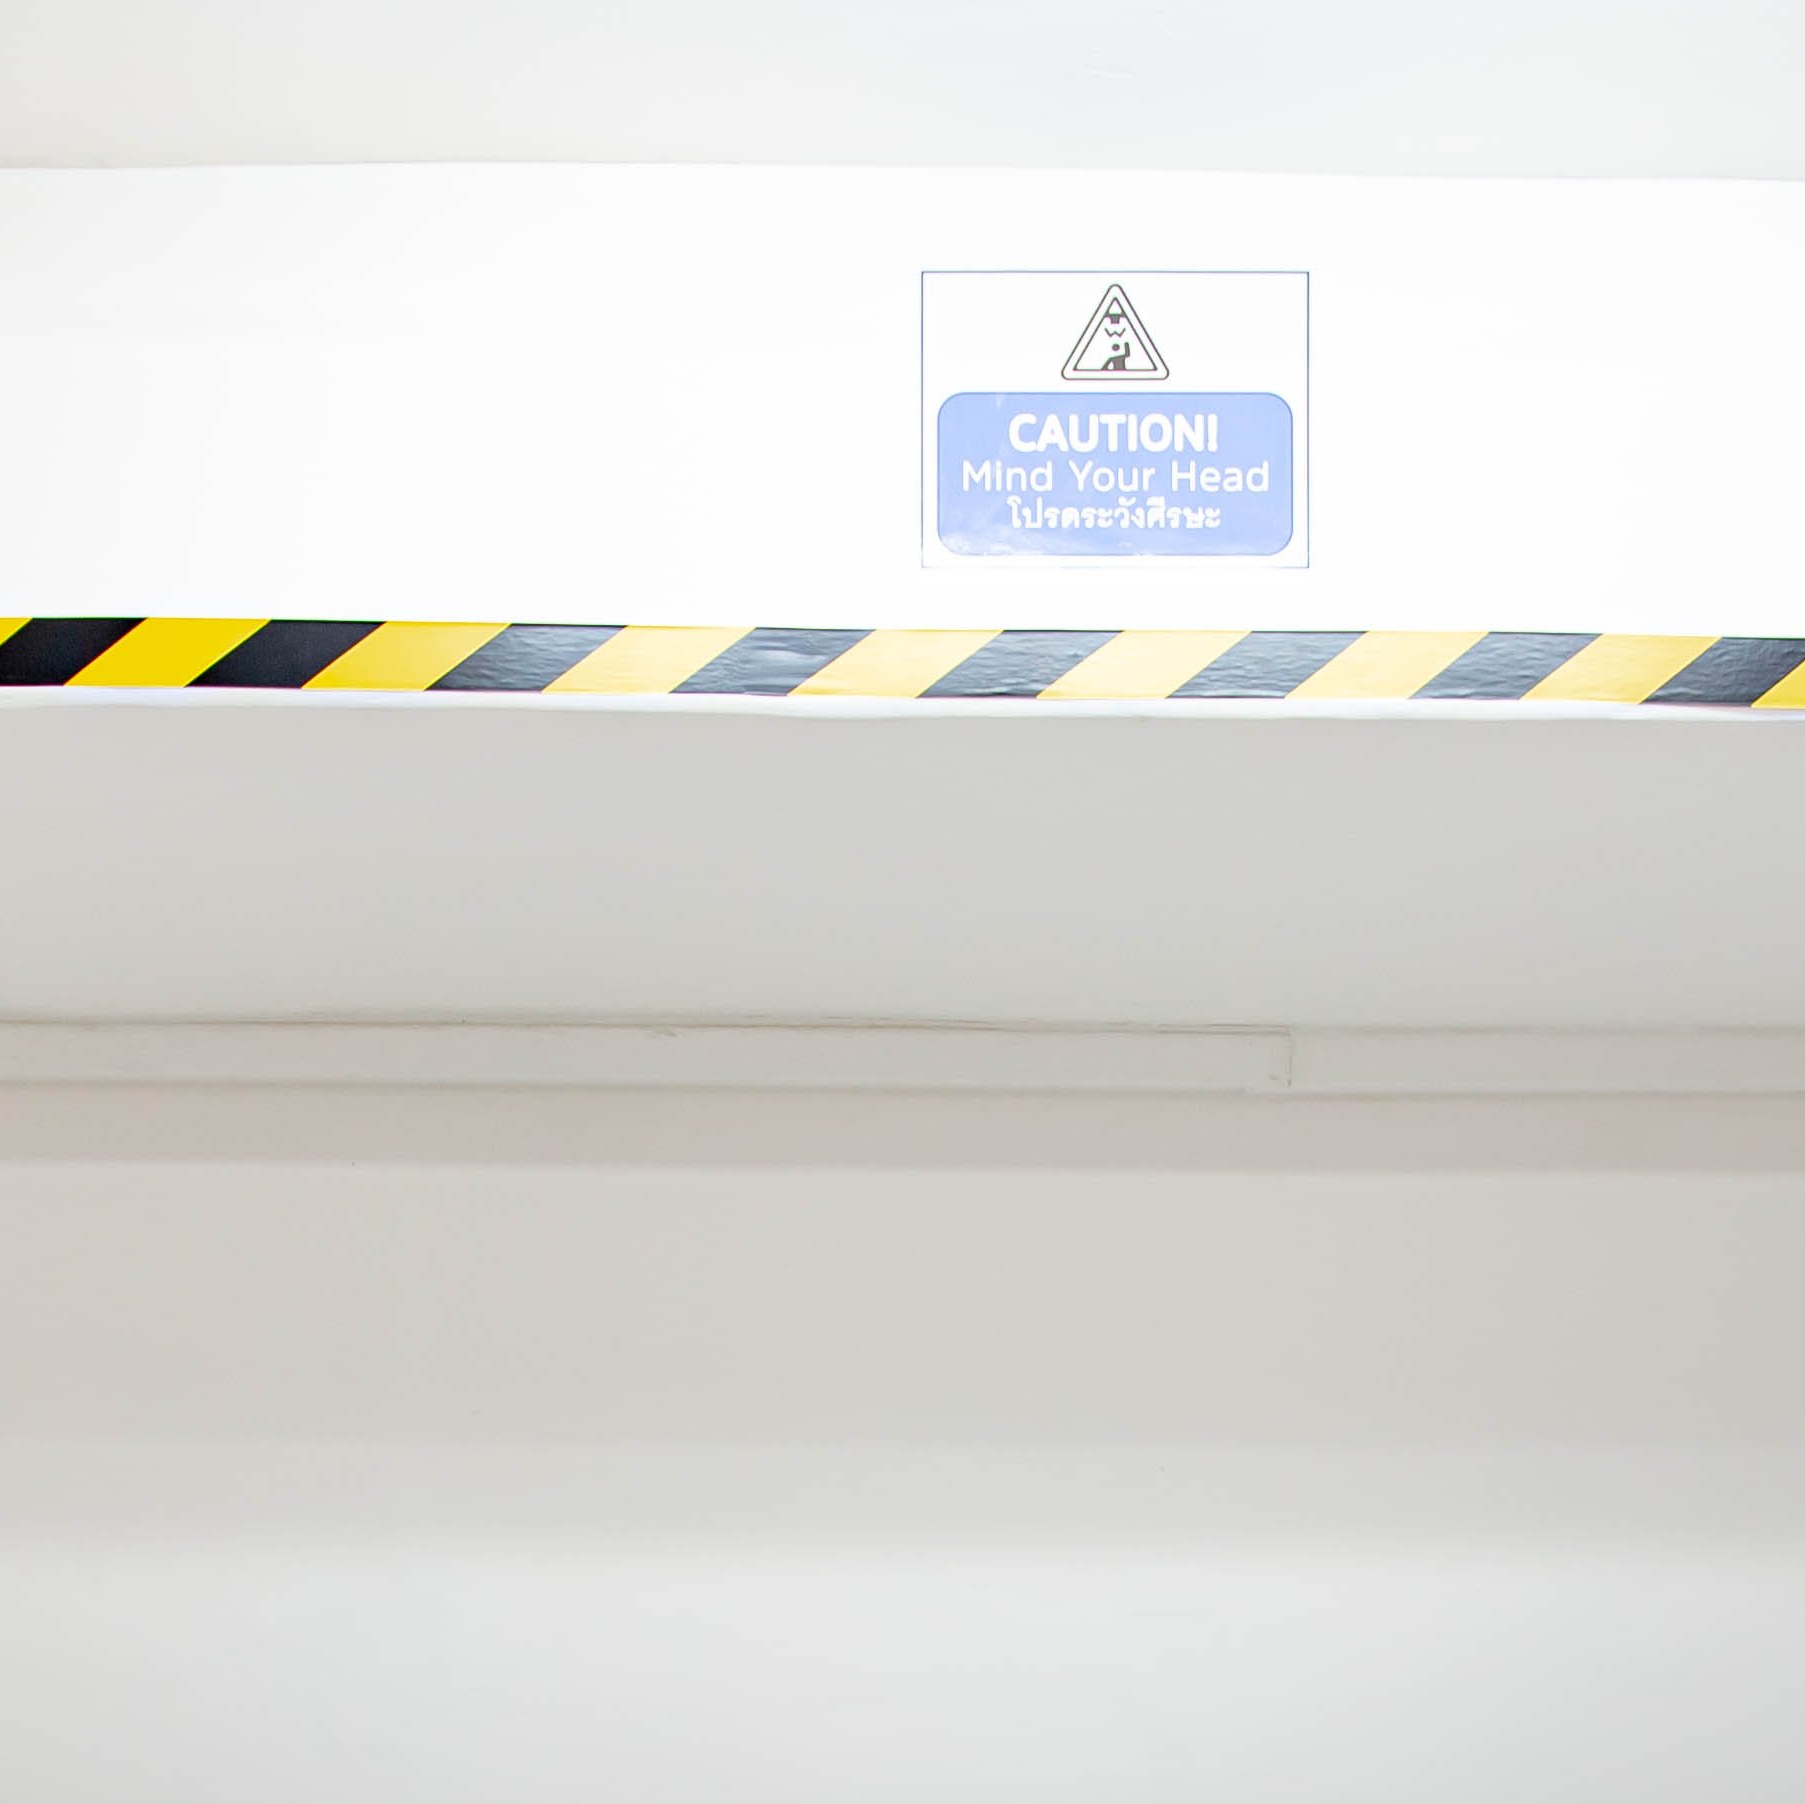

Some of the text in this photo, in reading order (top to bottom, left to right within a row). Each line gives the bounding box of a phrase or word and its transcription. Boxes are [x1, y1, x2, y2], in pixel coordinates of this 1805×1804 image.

[1008, 413, 1218, 453] CAUTION!
[963, 460, 1270, 492] Mind Your Head
[1007, 496, 1221, 529] โปรดระวังศีรษะ
